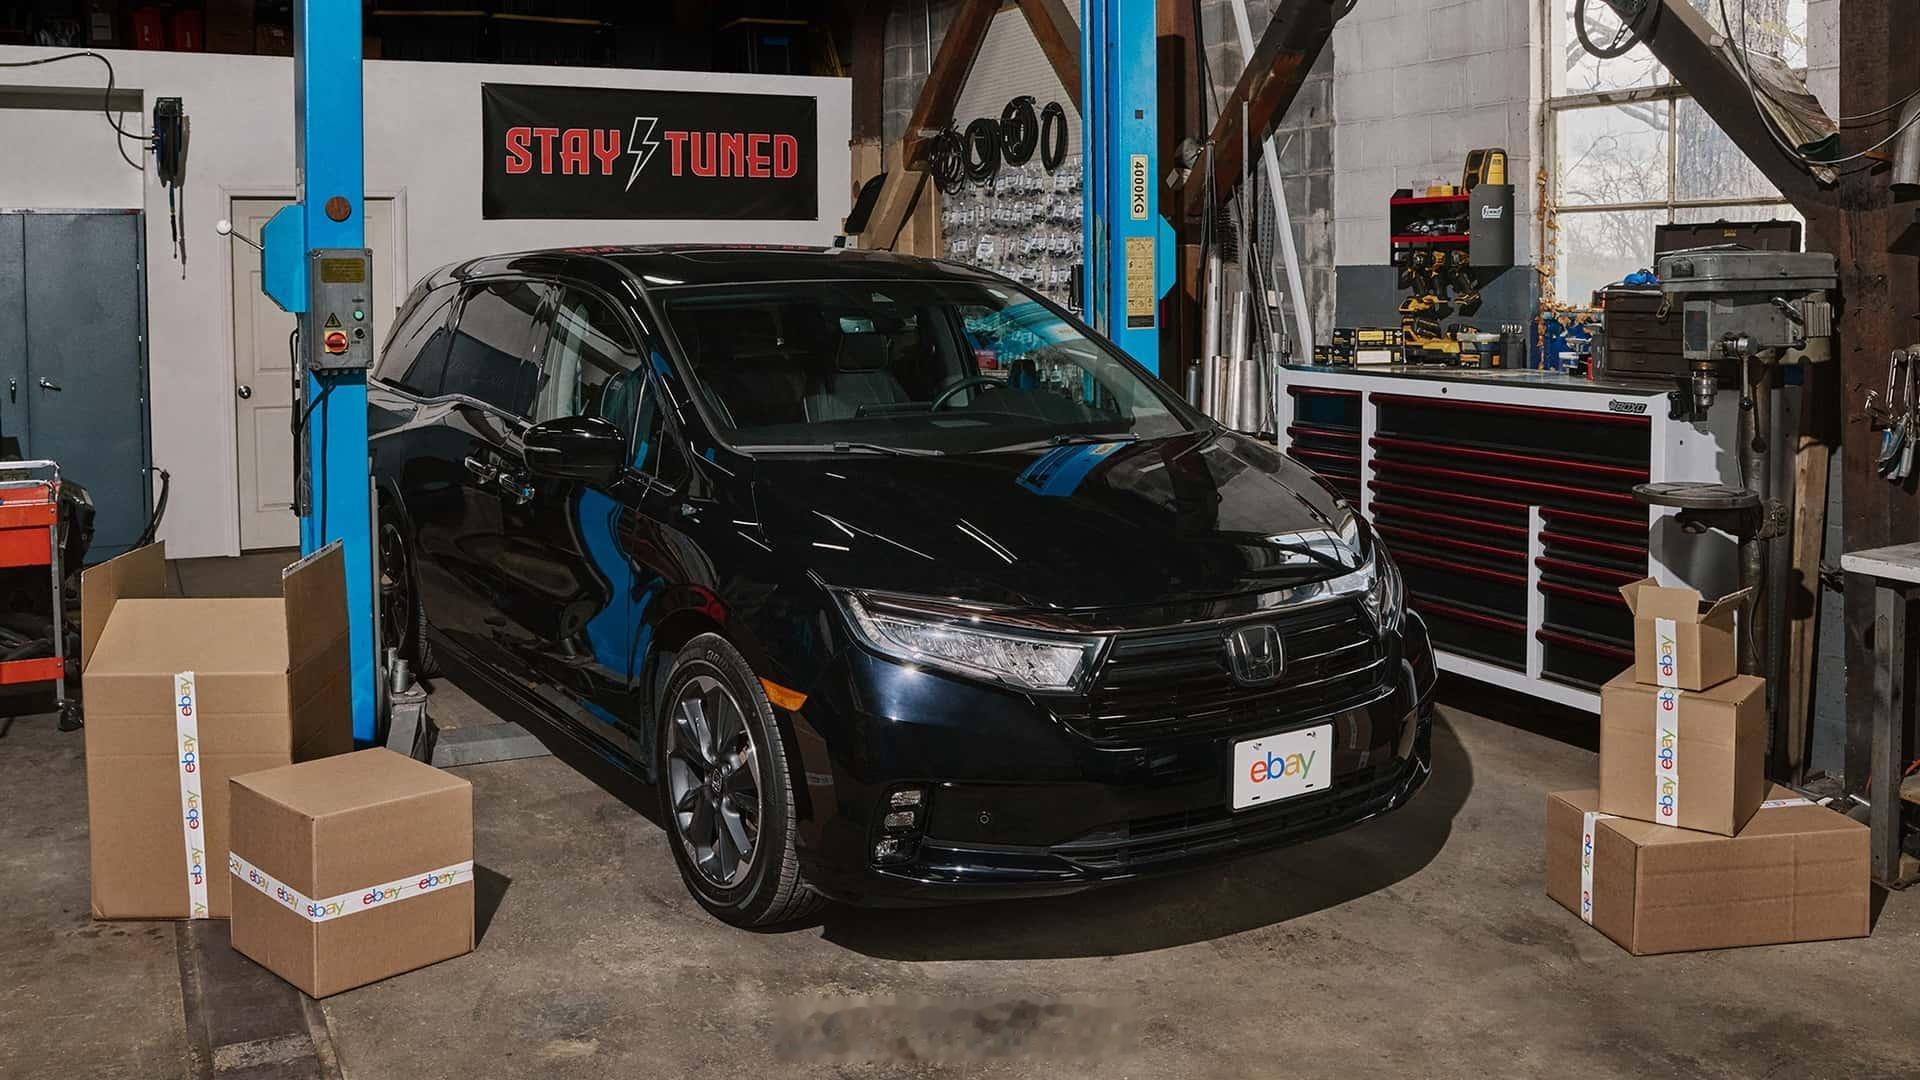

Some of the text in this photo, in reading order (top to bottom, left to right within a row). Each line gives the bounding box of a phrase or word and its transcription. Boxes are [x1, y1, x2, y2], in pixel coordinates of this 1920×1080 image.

[506, 127, 798, 178] STAY TUNED
[1134, 161, 1144, 213] 4000KG
[1659, 634, 1675, 676] ebay
[178, 677, 192, 716] ebay
[181, 734, 197, 773] ebay
[1250, 750, 1316, 783] ebay
[1658, 690, 1676, 816] ebay ebay eb
[186, 790, 200, 829] ebay
[190, 847, 203, 884] ebay
[1583, 833, 1593, 875] ebay
[249, 869, 270, 892] ebay
[277, 886, 299, 909] ebay
[307, 900, 345, 917] ebay
[363, 887, 401, 904] ebay
[419, 871, 456, 889] ebay
